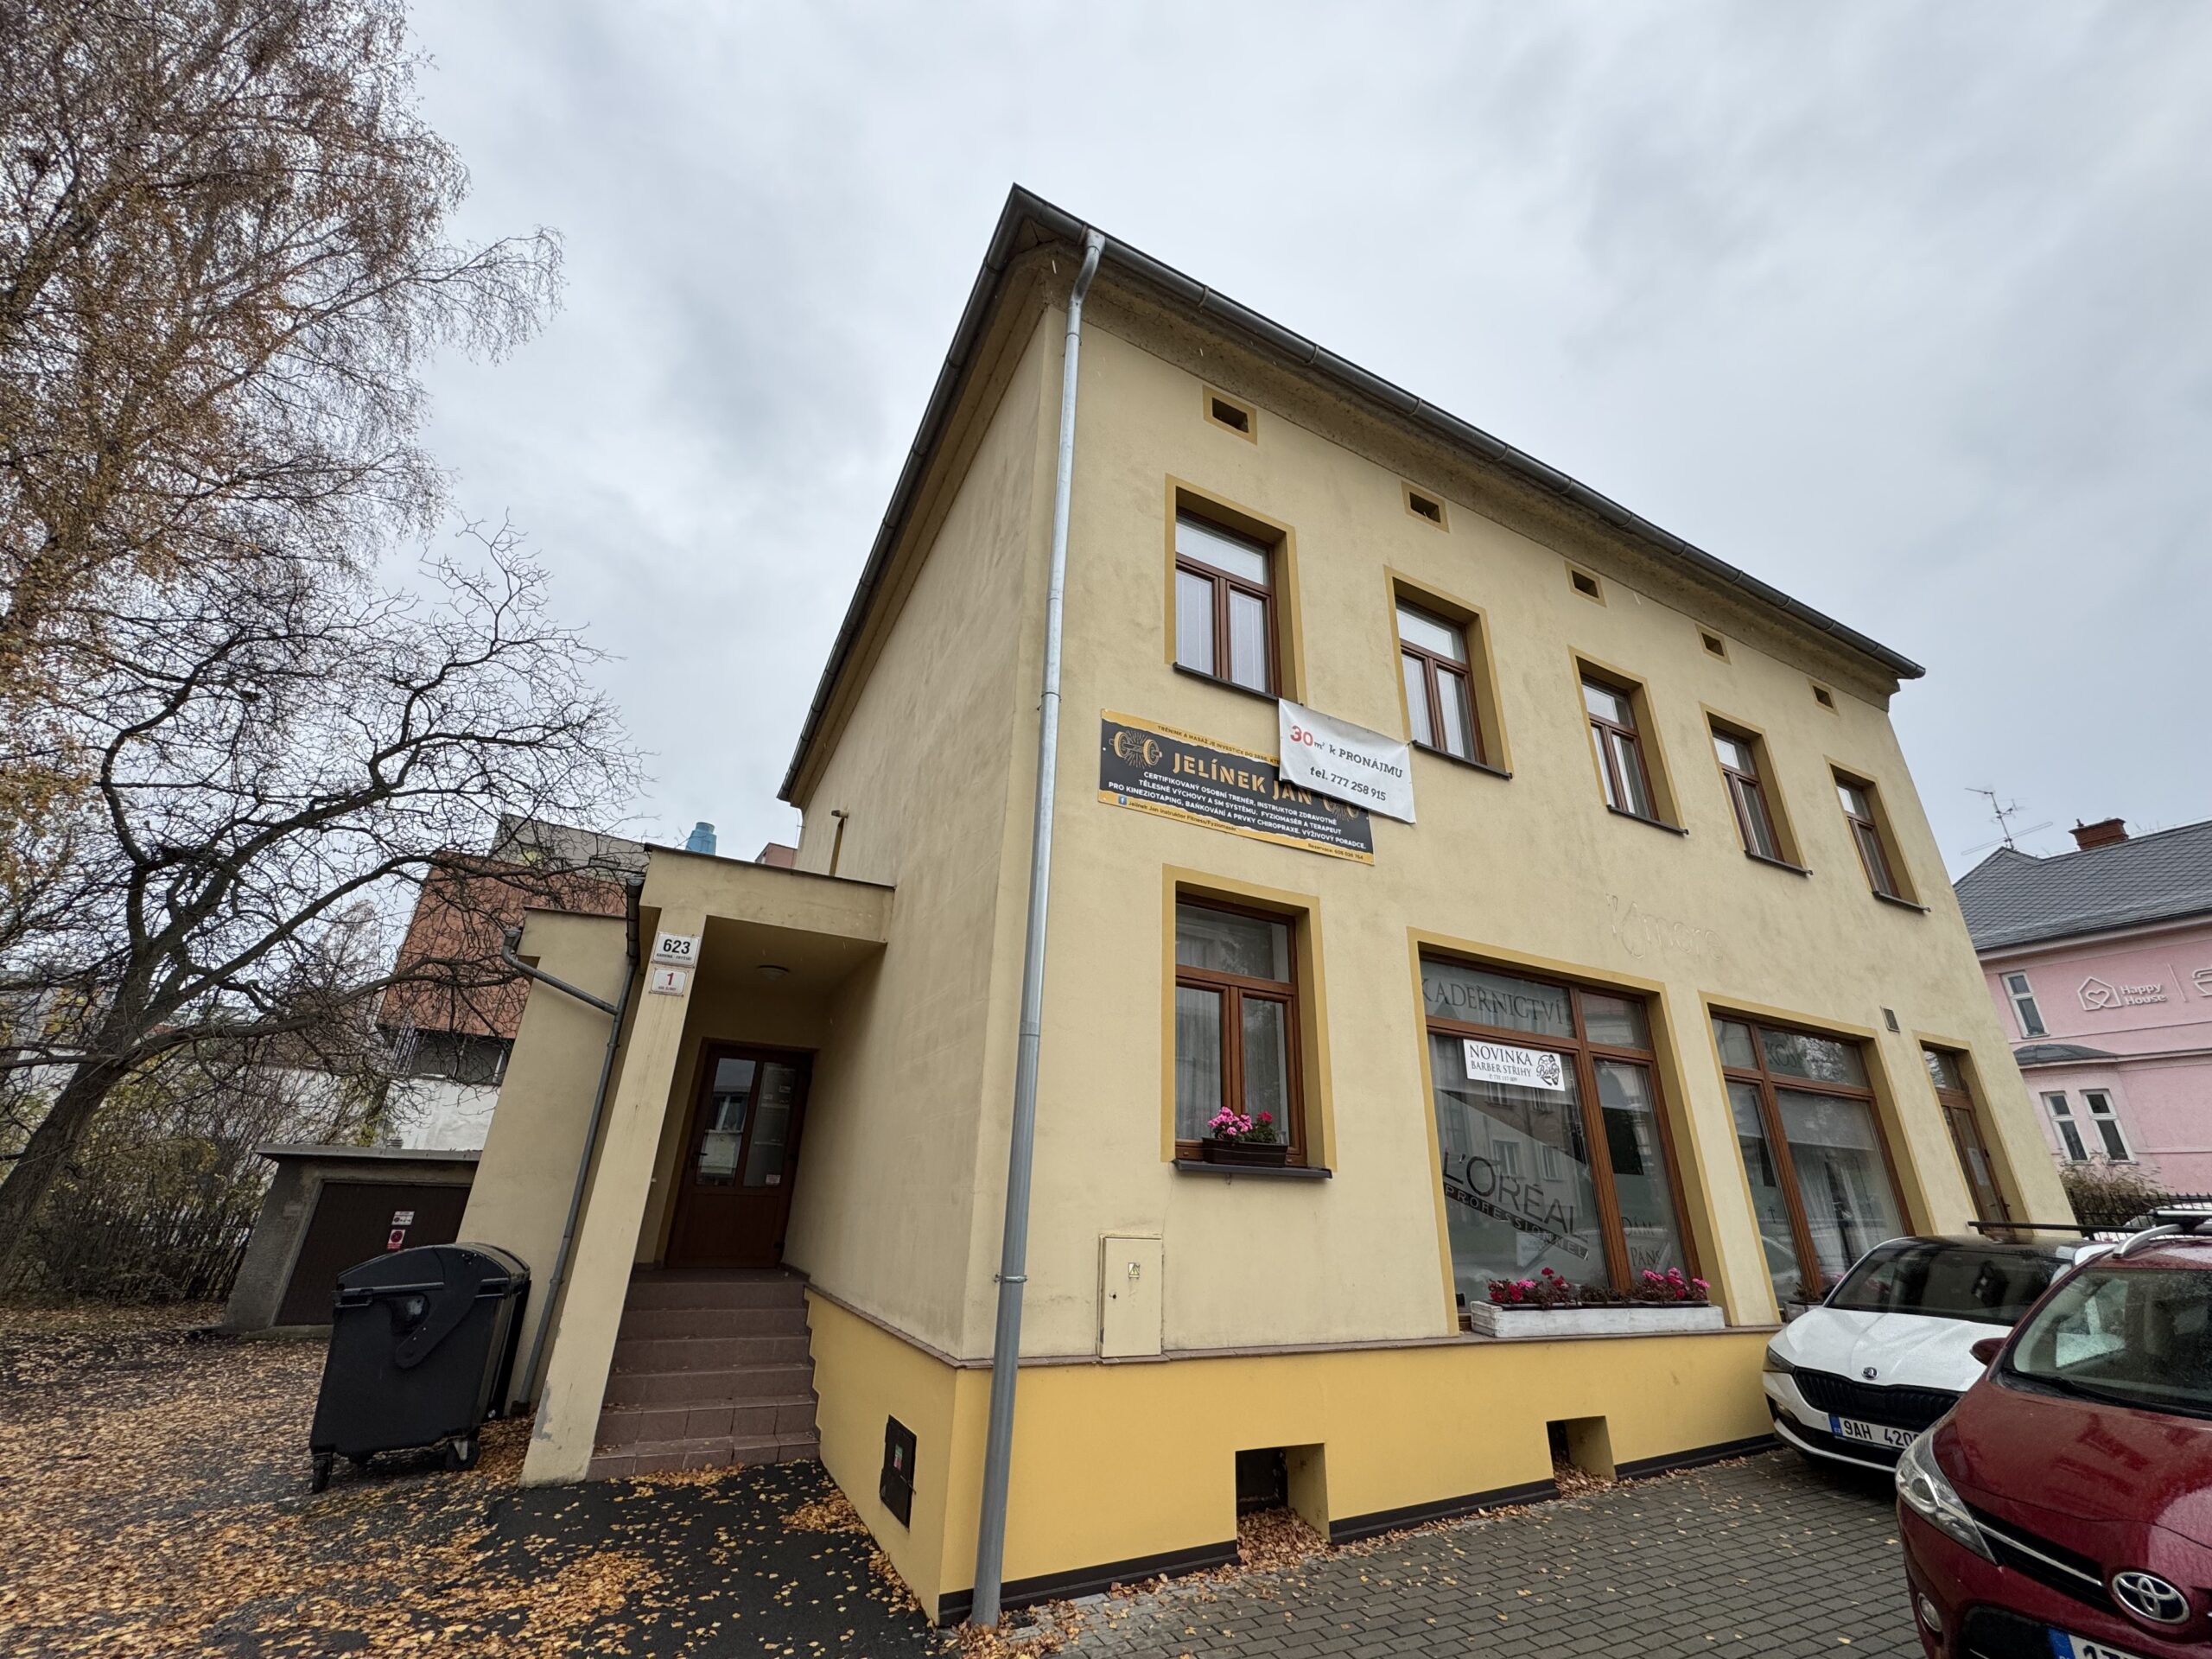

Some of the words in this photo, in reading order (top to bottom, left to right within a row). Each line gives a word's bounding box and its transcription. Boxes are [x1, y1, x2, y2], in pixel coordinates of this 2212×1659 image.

[1157, 725, 1182, 736] TRÉNINK
[1188, 734, 1208, 746] MASÁŽ
[1217, 743, 1244, 755] INVESTICE
[1329, 745, 1336, 756] k
[1338, 747, 1403, 779] PRONÁJMU
[1173, 753, 1267, 794] JELÍNEK
[1272, 779, 1313, 805] JAN
[1310, 766, 1329, 781] tel.
[1331, 773, 1350, 787] 777
[1351, 781, 1369, 795] 258
[1370, 788, 1387, 802] 915
[1143, 771, 1199, 791] CERTIFIKOVANÝ
[1201, 785, 1228, 799] OSOBNÍ
[1256, 802, 1298, 817] INSTRUKTOR
[1108, 781, 1125, 791] PRO
[1126, 785, 1185, 806] KINEZIOTAPING,
[1185, 800, 1226, 816] BAŇKOVÁNÍ
[1233, 813, 1256, 823] PRVKY
[1301, 827, 1335, 842] VÝŽIVOVÝ
[1335, 836, 1367, 849] PORADCE.
[1139, 779, 1171, 793] TĚLESNÉ
[1172, 787, 1206, 803] VÝCHOVY
[1261, 810, 1303, 826] FYZIOMASÉR
[1309, 822, 1342, 836] TERAPEUT
[1160, 807, 1186, 819] Instruktor
[663, 938, 691, 955] 623
[666, 972, 674, 986] 1
[2120, 982, 2163, 995] Happy
[2124, 995, 2168, 1006] House
[1469, 1044, 1534, 1066] NOVINKA
[1471, 1060, 1503, 1073] BARBER
[1503, 1064, 1532, 1077] STŘIHY
[1843, 1420, 1873, 1440] 9AH
